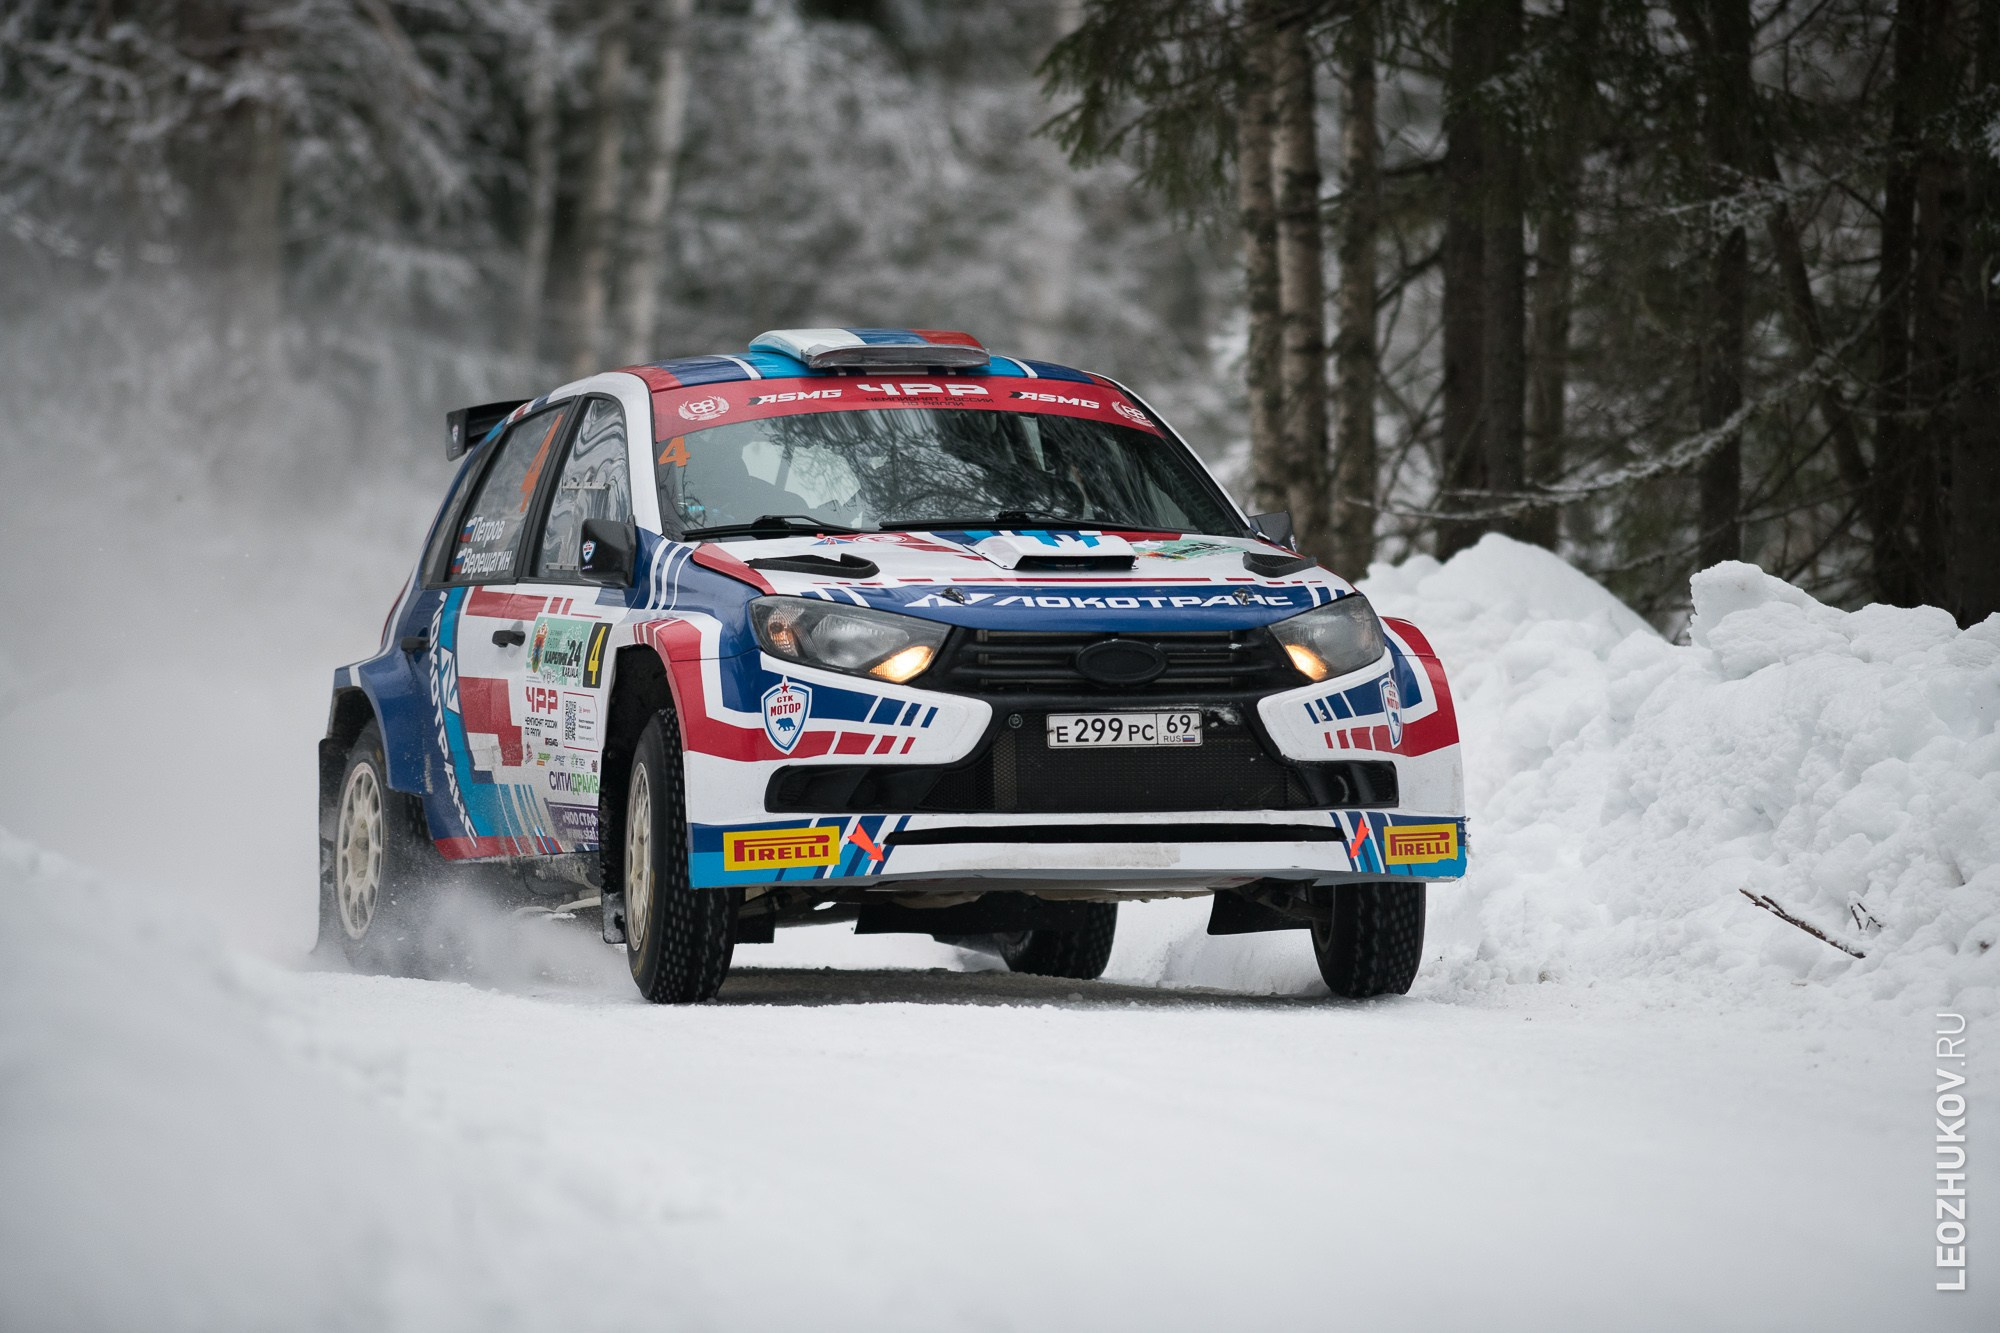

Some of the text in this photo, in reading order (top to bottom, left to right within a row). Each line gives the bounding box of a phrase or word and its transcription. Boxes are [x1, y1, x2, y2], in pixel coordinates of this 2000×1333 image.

[757, 390, 842, 404] ASMG
[1017, 391, 1100, 409] ASMG
[658, 436, 690, 467] 4
[471, 517, 505, 548] Петров
[461, 548, 512, 580] Верещагин
[993, 594, 1294, 609] ЛОКОТРАНС
[588, 626, 606, 685] 4
[770, 703, 801, 717] МОТОР
[777, 695, 793, 703] СТК
[429, 591, 478, 848] ЛОКОТРАНС
[1166, 715, 1192, 734] 69
[734, 835, 830, 862] PIRELLI
[1390, 832, 1450, 856] PIRELLI
